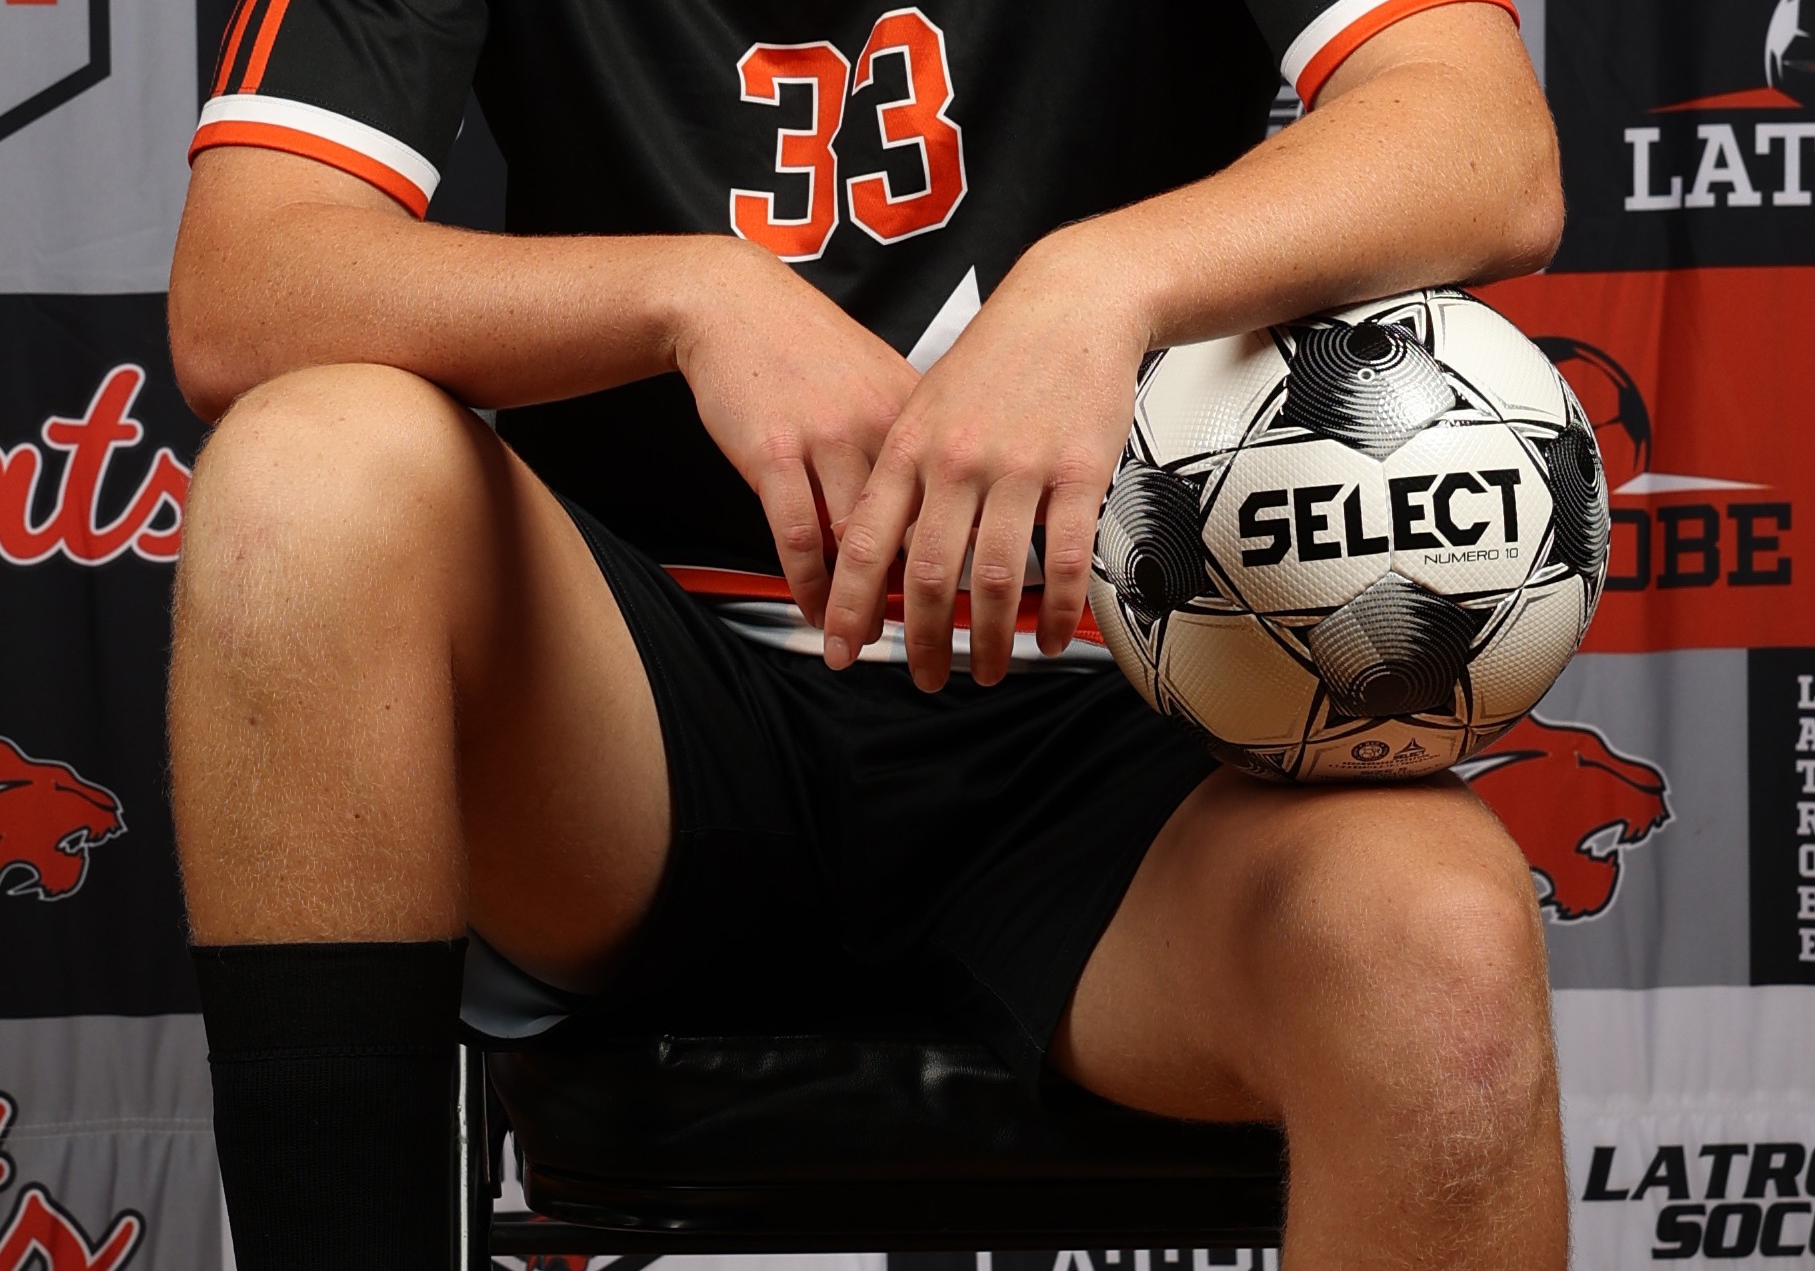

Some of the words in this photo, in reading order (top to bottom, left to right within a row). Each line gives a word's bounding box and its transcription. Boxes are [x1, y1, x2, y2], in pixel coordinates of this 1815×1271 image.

[730, 6, 969, 264] 33
[1624, 122, 1815, 212] LAT
[1238, 467, 1521, 567] SELECT
[1424, 549, 1499, 565] NUMERO
[1505, 547, 1519, 559] 10
[1581, 1141, 1815, 1202] LATR
[1651, 1201, 1815, 1260] SOC
